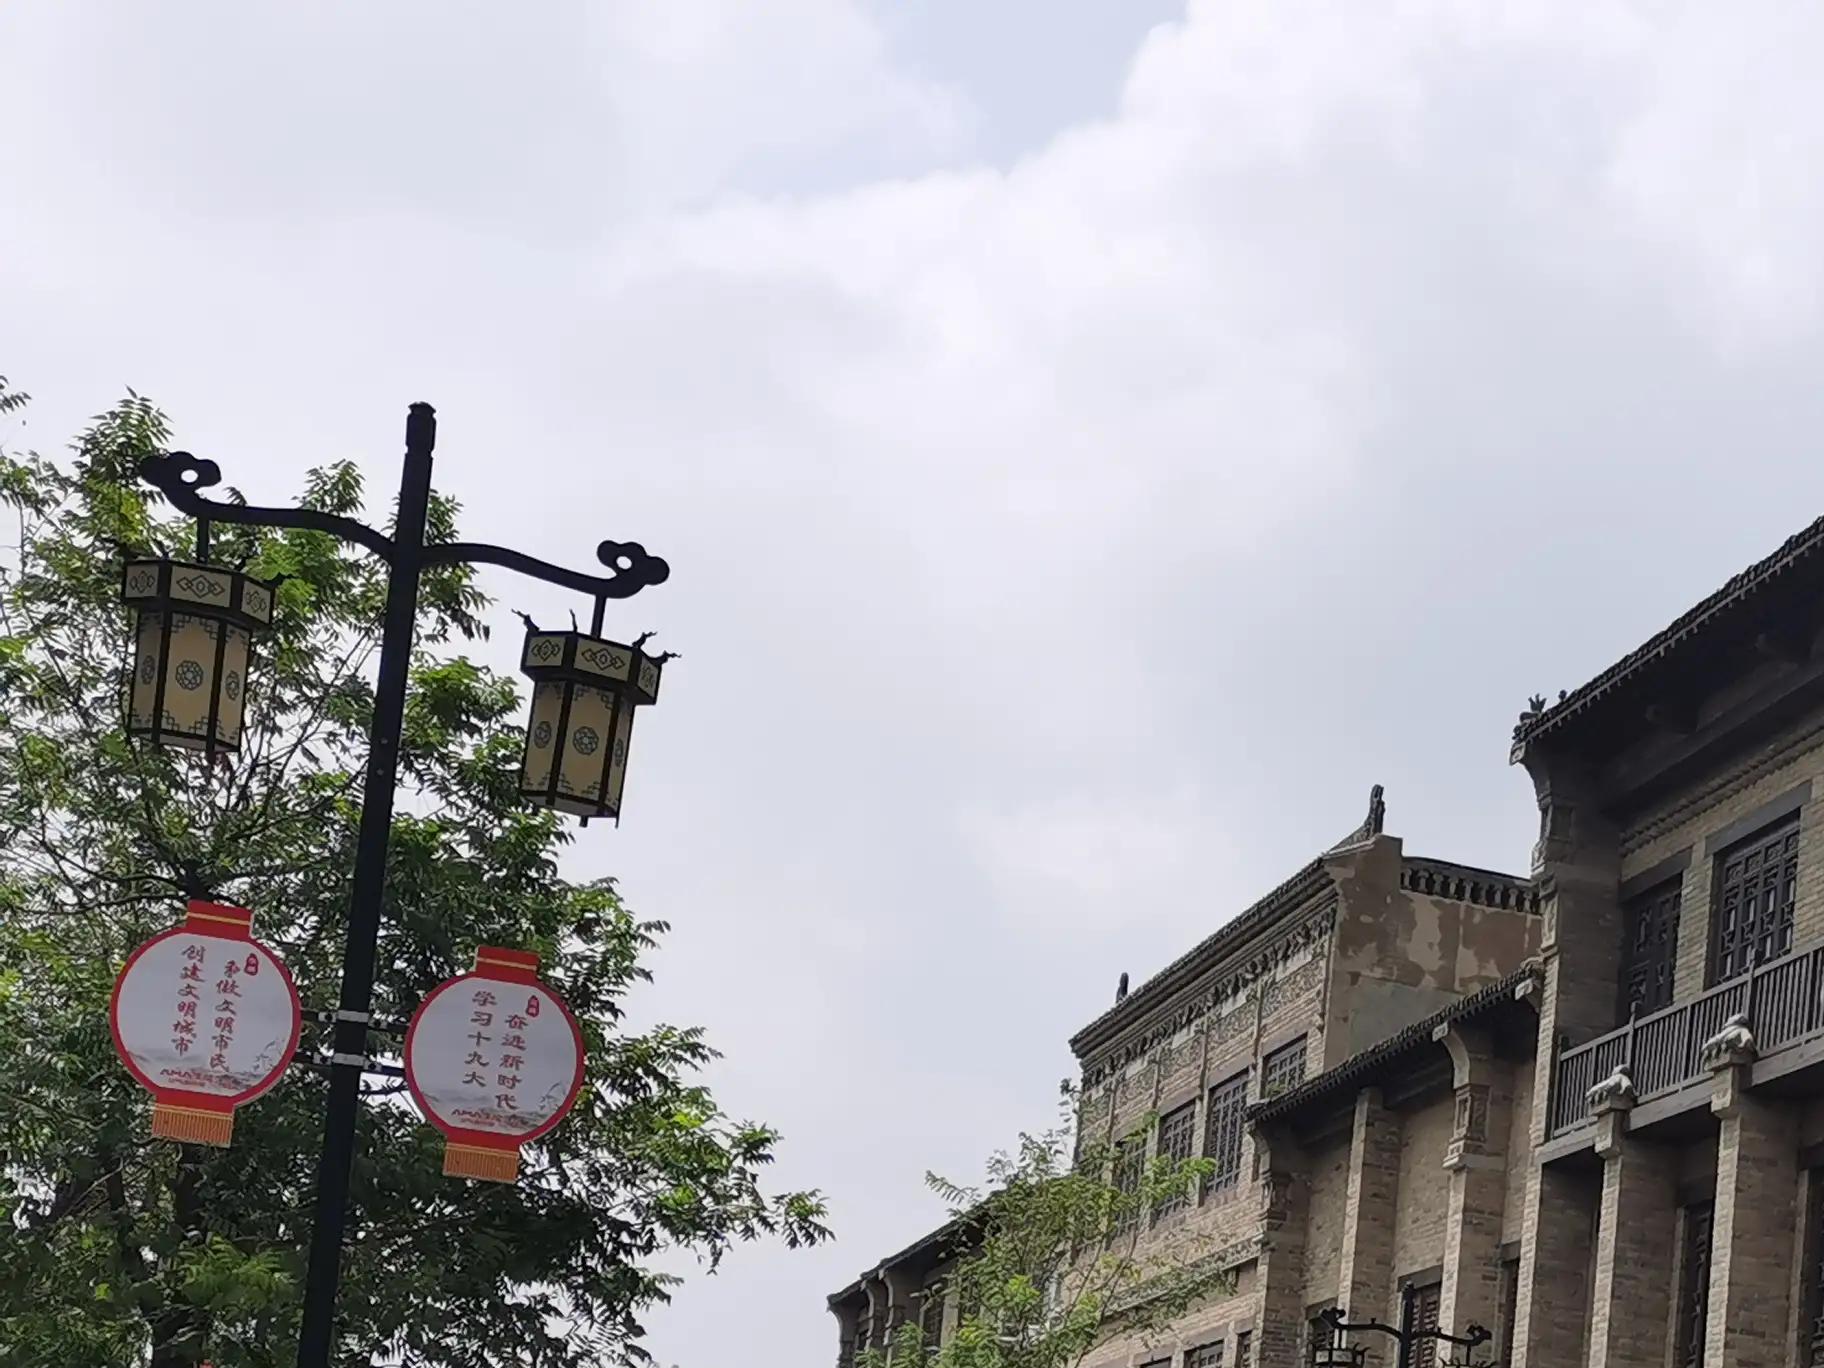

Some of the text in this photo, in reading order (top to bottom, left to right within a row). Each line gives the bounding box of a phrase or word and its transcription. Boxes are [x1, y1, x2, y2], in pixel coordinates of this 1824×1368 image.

[171, 944, 206, 1057] 创建文明城市
[210, 960, 242, 1073] 争做文明市民
[461, 990, 498, 1088] 学习十九大
[495, 1014, 529, 1111] 奋进新时代
